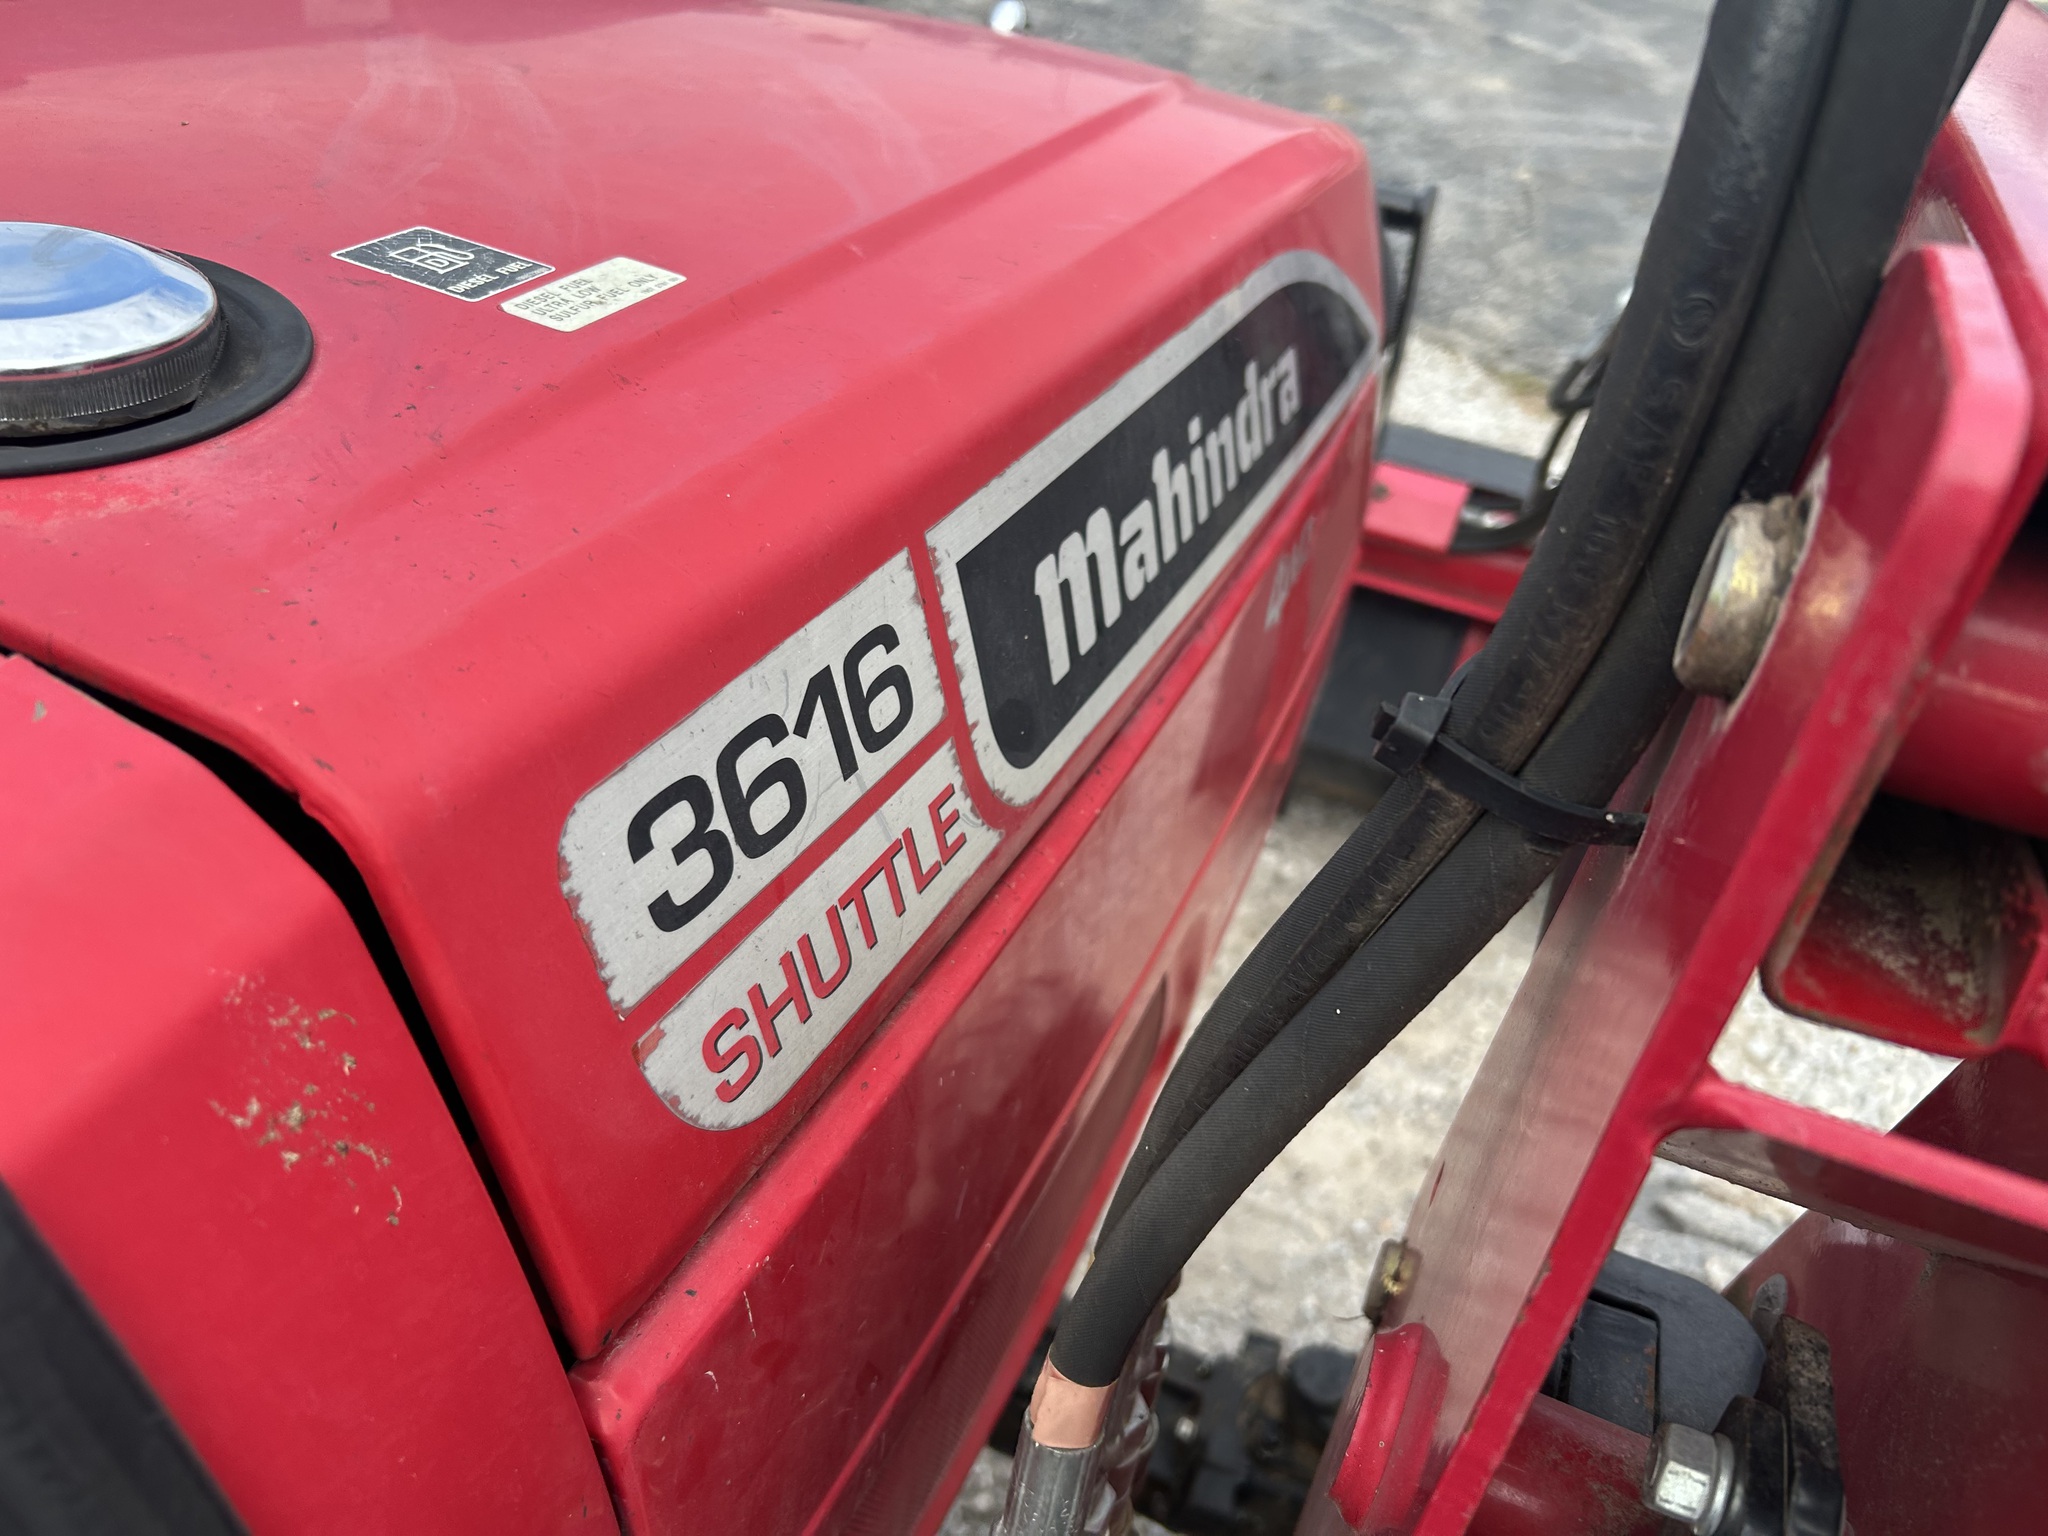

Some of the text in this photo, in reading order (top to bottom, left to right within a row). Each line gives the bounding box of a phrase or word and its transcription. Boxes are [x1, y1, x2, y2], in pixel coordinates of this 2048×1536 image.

[447, 273, 500, 293] DIESEL
[495, 261, 534, 275] FUEL
[514, 278, 594, 310] DIESEL FUEL
[531, 285, 602, 316] ULTRA LOW
[549, 299, 600, 322] SULFUR
[596, 287, 630, 304] FUEL
[627, 273, 659, 289] ONLY
[1034, 345, 1303, 686] Mahindra
[627, 622, 915, 933] 3616
[702, 782, 968, 1104] SHUTTLE
